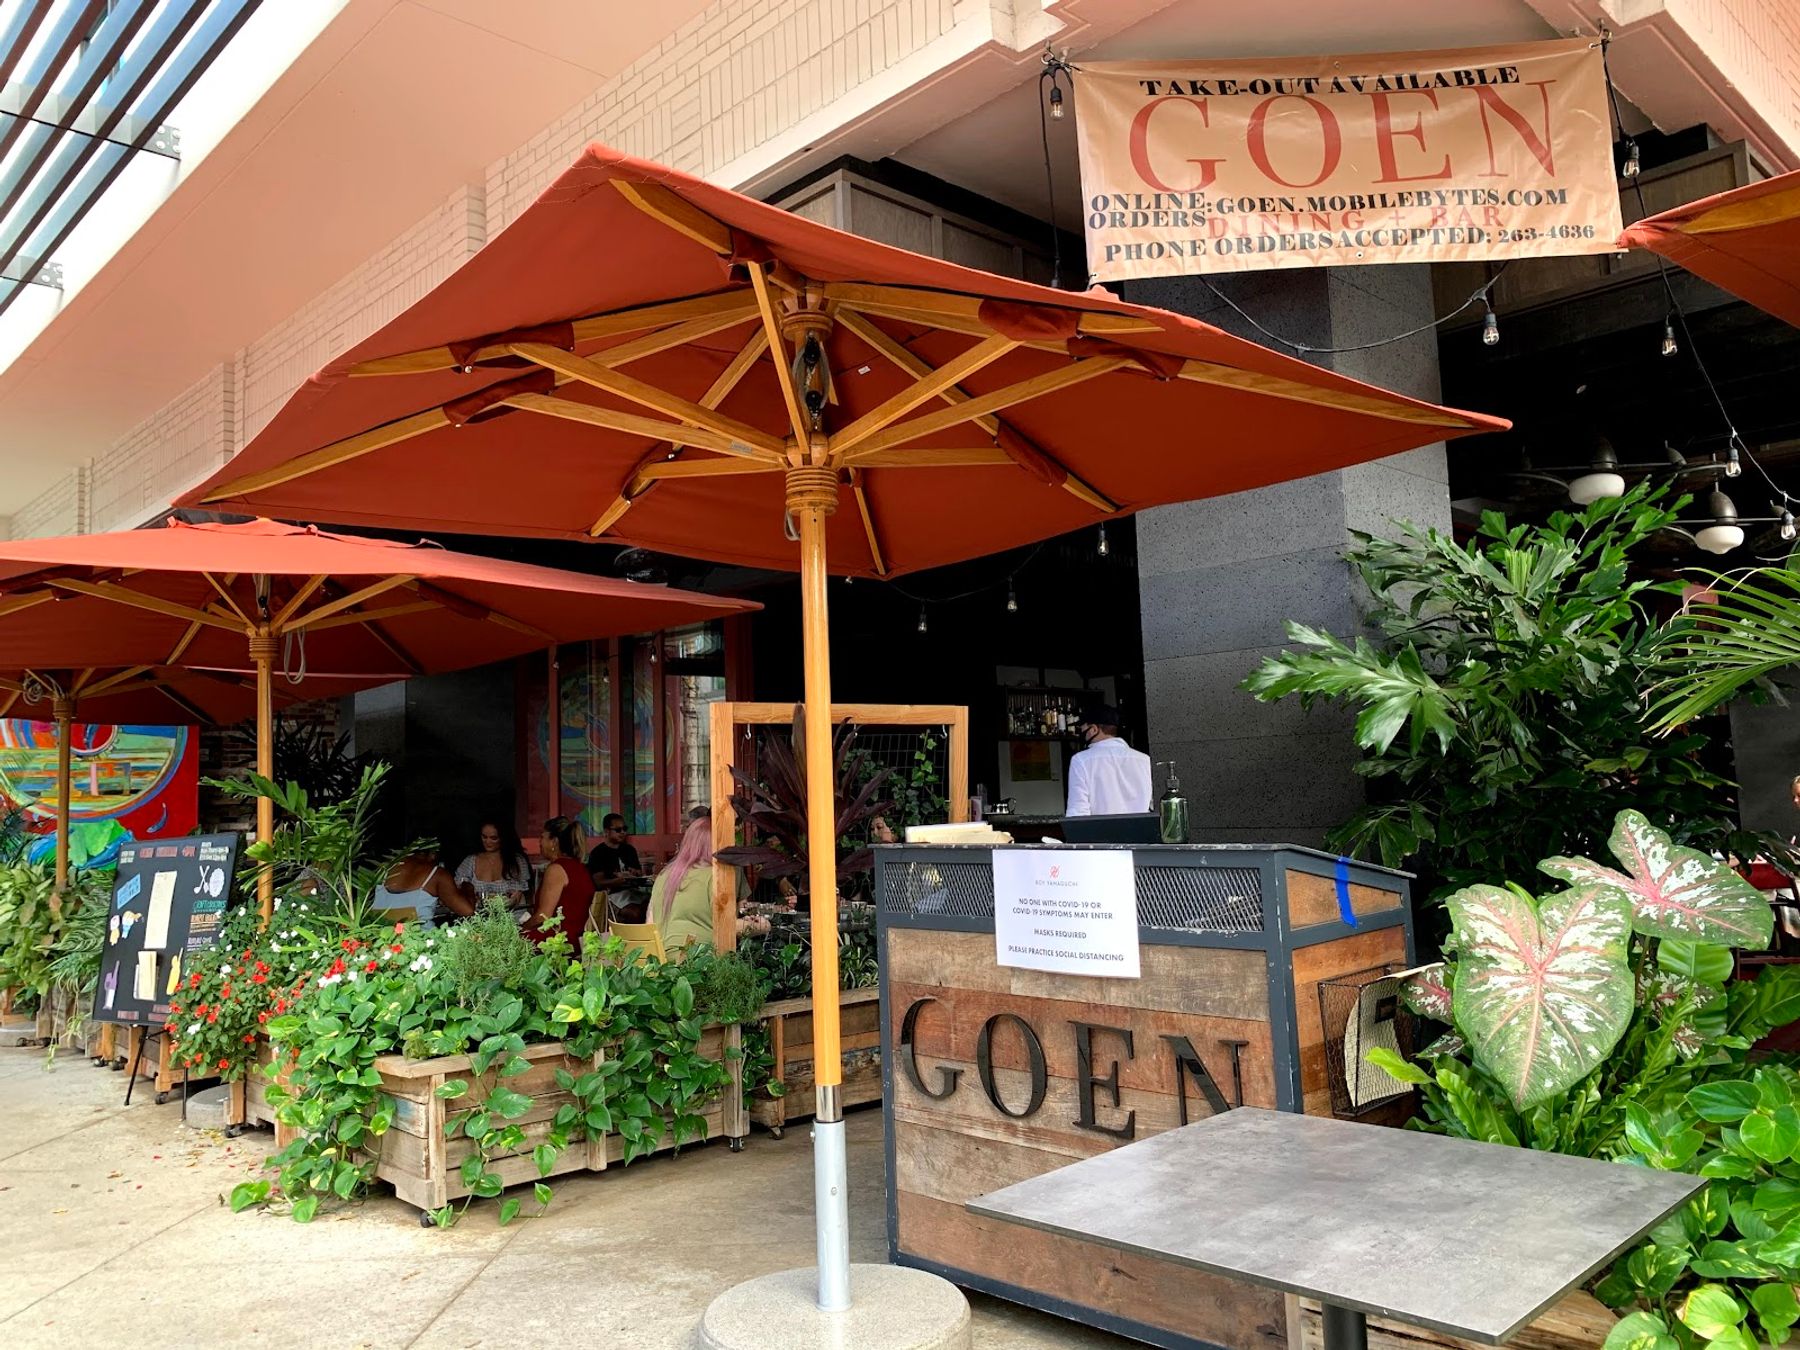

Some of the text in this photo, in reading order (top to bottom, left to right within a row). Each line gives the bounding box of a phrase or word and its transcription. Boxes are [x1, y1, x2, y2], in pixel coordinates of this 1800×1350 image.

[1139, 66, 1520, 96] TAKE-OUT AVAILABLE
[1129, 79, 1557, 193] GOEN
[1089, 211, 1207, 230] ORDERS
[1208, 211, 1365, 240] DINING
[1430, 206, 1504, 228] BAR
[1104, 225, 1595, 263] PHONE ORDERS ACCEPTED: 263-4636
[1039, 909, 1072, 918] SYMPTOMS
[1091, 912, 1113, 920] ENTER
[1058, 901, 1089, 909] COVID-19
[1034, 928, 1087, 939] MASKS REQUIRED
[1008, 945, 1124, 961] PLEASE PRACTICE SOCIAL DISTANCING
[901, 998, 1250, 1140] GOEN
